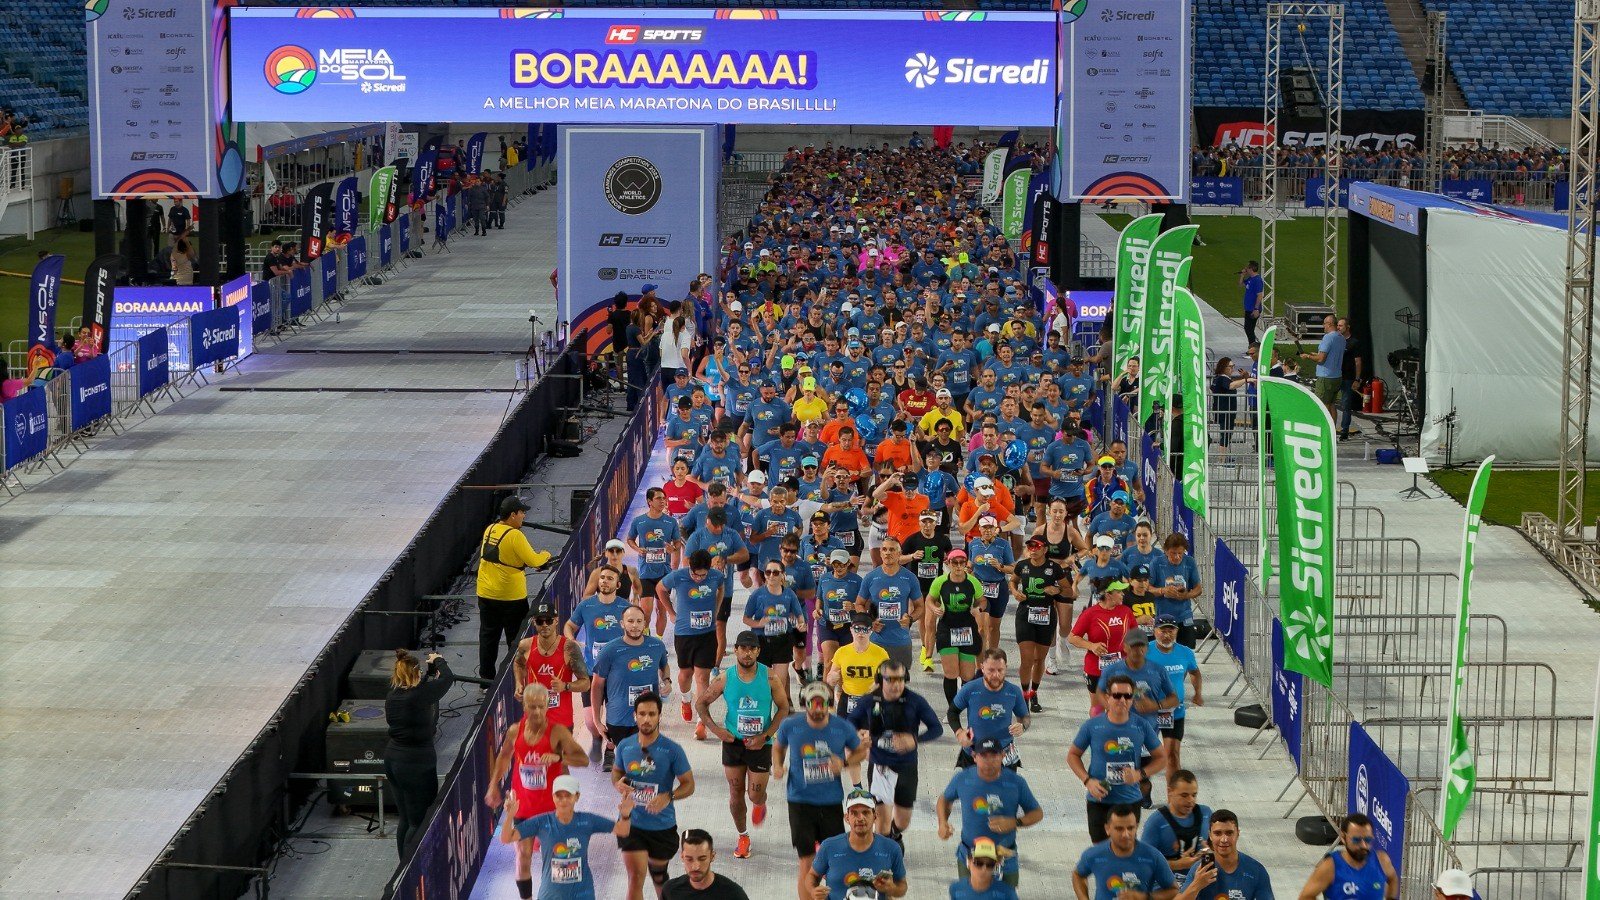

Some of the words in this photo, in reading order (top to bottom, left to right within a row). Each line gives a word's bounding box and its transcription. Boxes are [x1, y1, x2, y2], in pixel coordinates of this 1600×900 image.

[137, 8, 177, 19] Sicredi
[1115, 10, 1155, 21] Sicredi
[609, 28, 637, 42] HC
[642, 29, 703, 42] SPORTS
[319, 48, 394, 64] MEIA
[319, 65, 341, 74] DO
[340, 64, 407, 81] SOL
[514, 53, 808, 85] BORAAAAAAA!
[944, 59, 1050, 85] Sicredi
[372, 82, 406, 92] Sicredi
[483, 98, 495, 109] A
[500, 98, 570, 110] MELHOR
[575, 98, 616, 110] MEIA
[620, 98, 712, 110] MARATONA
[716, 98, 743, 110] DO
[747, 98, 836, 111] BRASILLLL!
[988, 153, 1002, 192] Sicredi
[1012, 174, 1025, 219] Sicredi
[312, 195, 322, 238] SPORTS
[1040, 200, 1051, 242] SPORTS
[310, 240, 320, 256] HC
[602, 236, 620, 245] HC
[624, 236, 667, 245] SPORTS
[1038, 244, 1047, 260] HC
[95, 267, 108, 325] SPORTS
[211, 324, 236, 344] Sicredi
[1283, 420, 1324, 598] Sicredi
[1108, 616, 1124, 626] MG
[537, 663, 554, 676] MG
[1372, 796, 1393, 838] Cristalina
